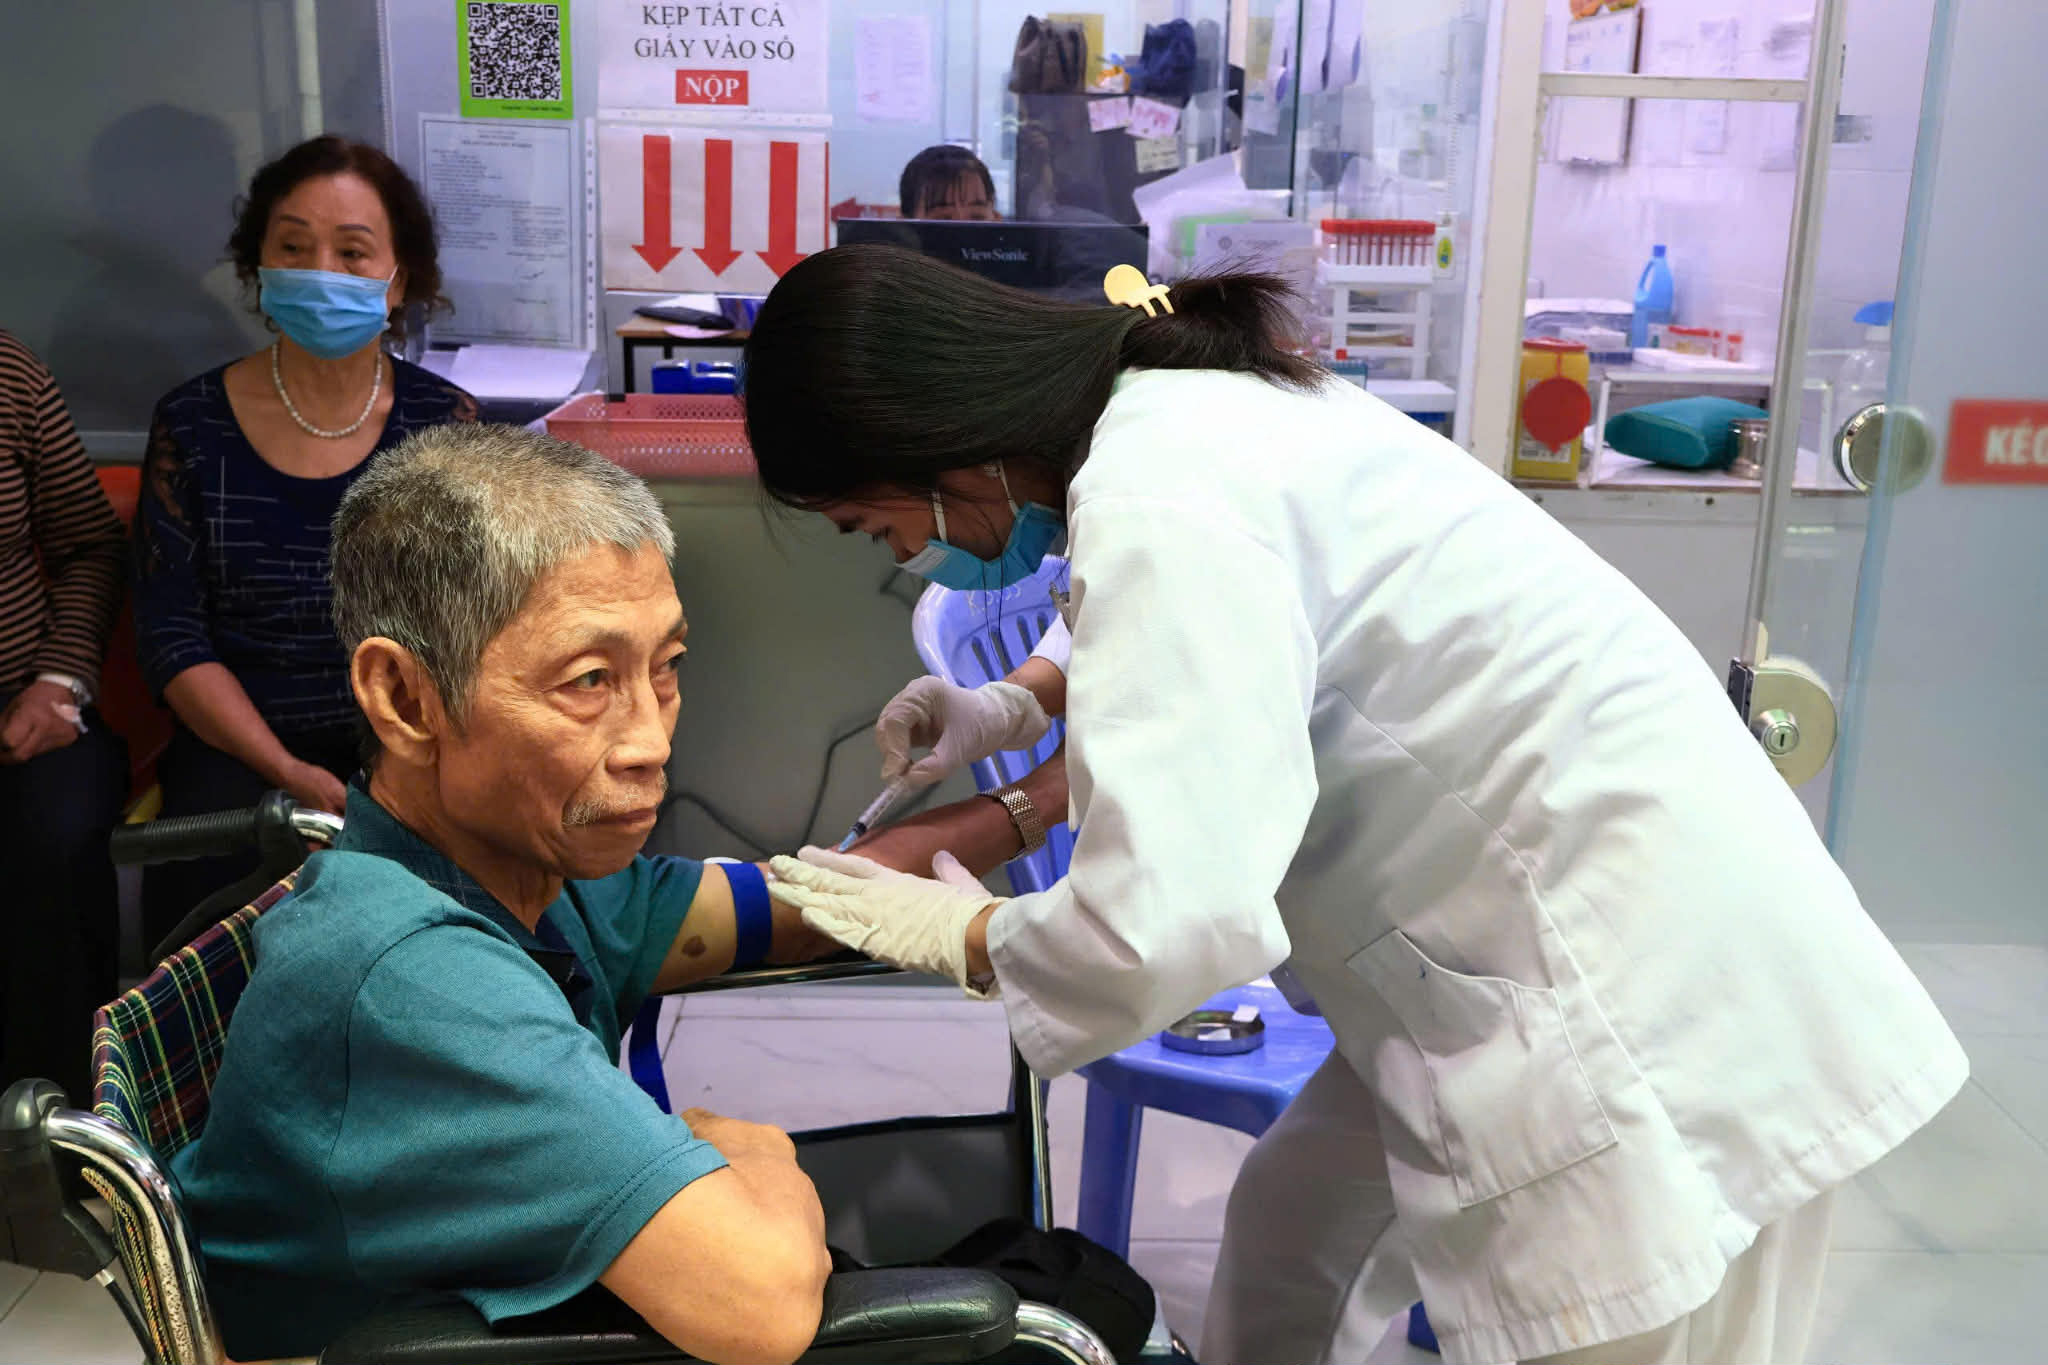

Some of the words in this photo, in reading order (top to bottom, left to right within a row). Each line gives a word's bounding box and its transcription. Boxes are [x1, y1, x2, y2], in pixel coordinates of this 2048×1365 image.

[642, 5, 689, 29] KẸP
[703, 33, 757, 60] VÀO
[685, 75, 740, 103] NỘP
